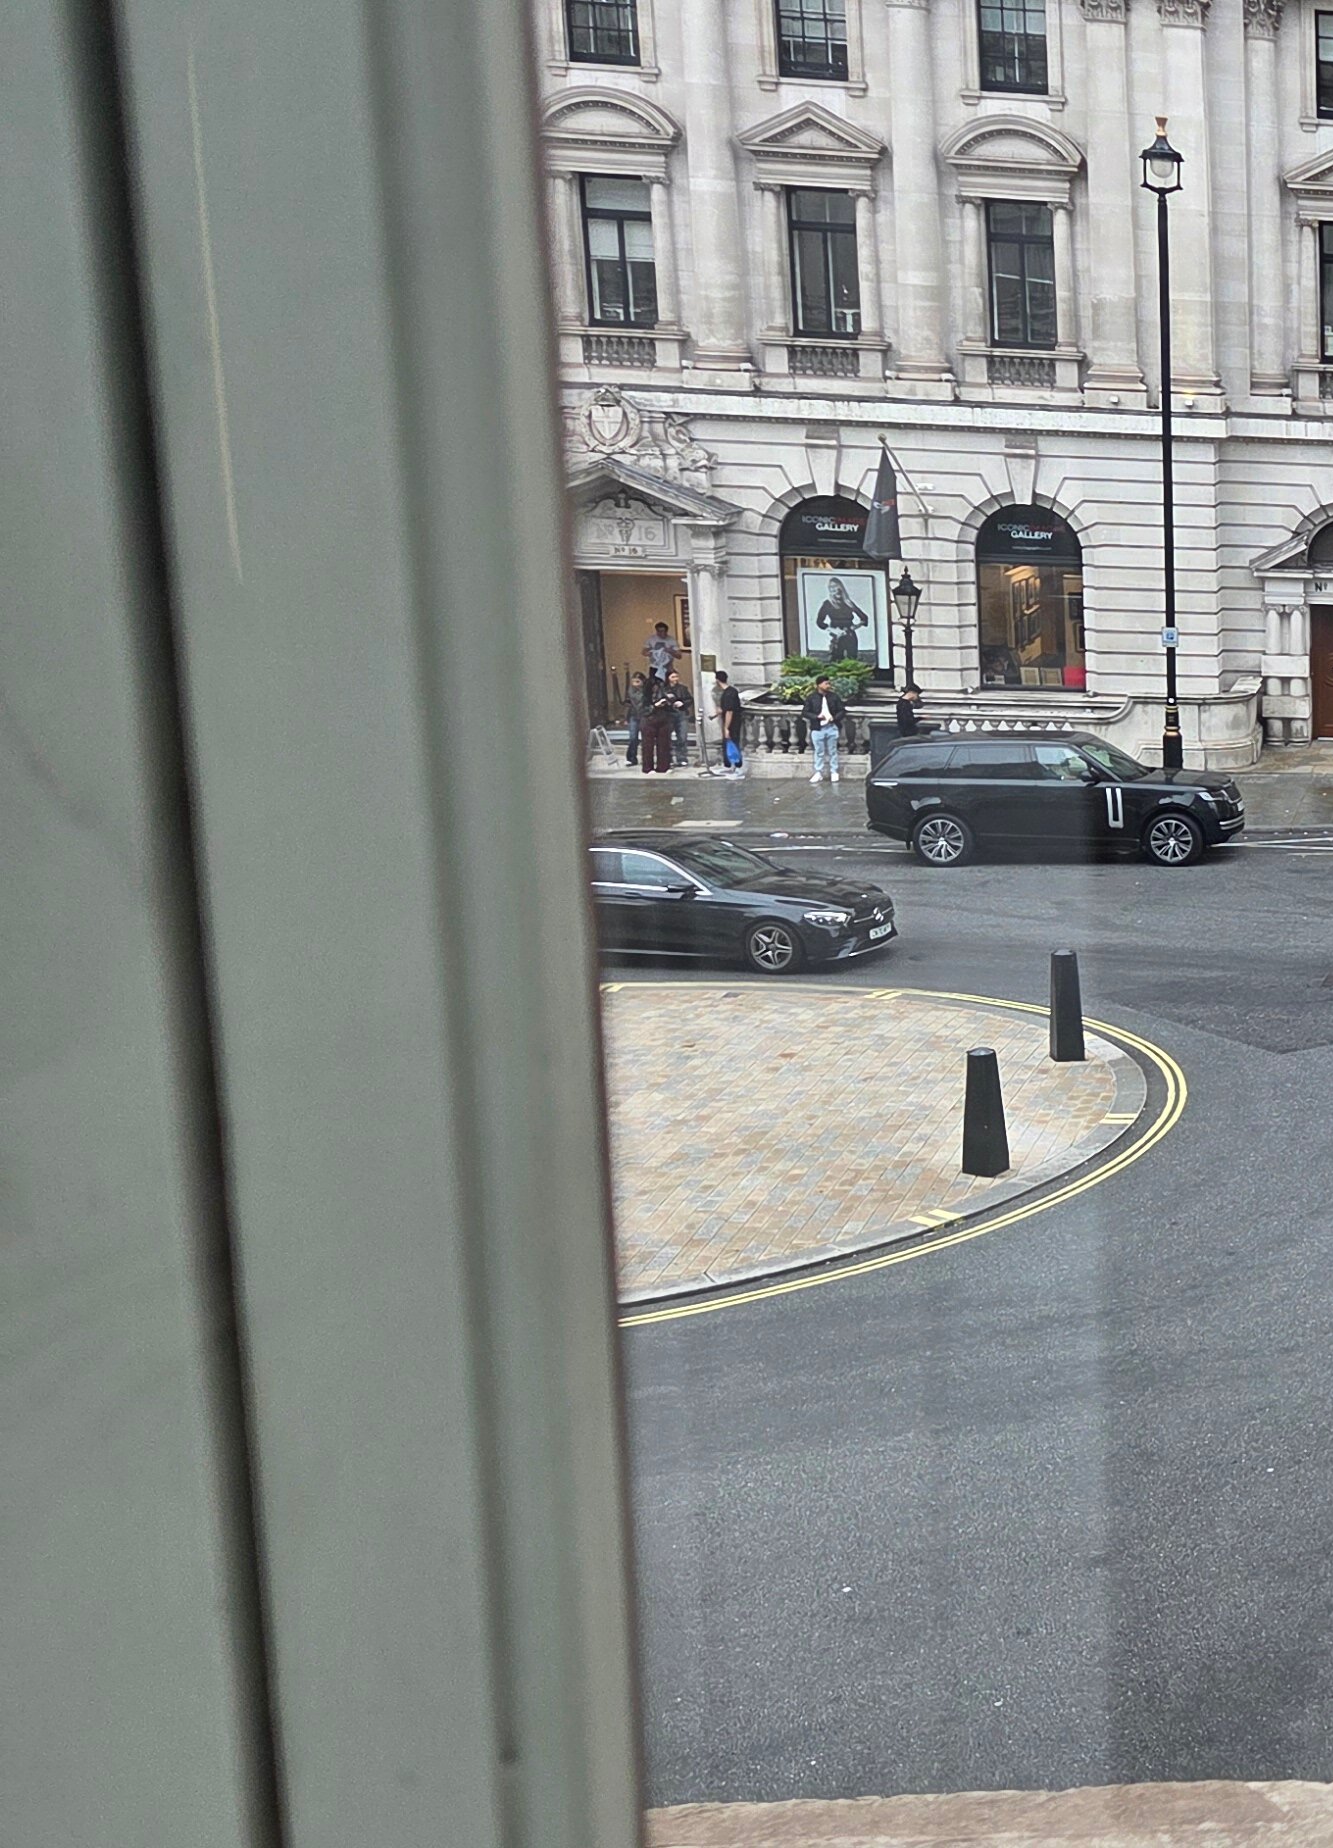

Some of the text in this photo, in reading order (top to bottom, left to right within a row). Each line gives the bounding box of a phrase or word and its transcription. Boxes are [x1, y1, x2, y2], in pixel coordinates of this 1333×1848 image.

[815, 523, 859, 532] GALLERY
[637, 525, 657, 542] 16
[1010, 531, 1053, 539] GALLERY
